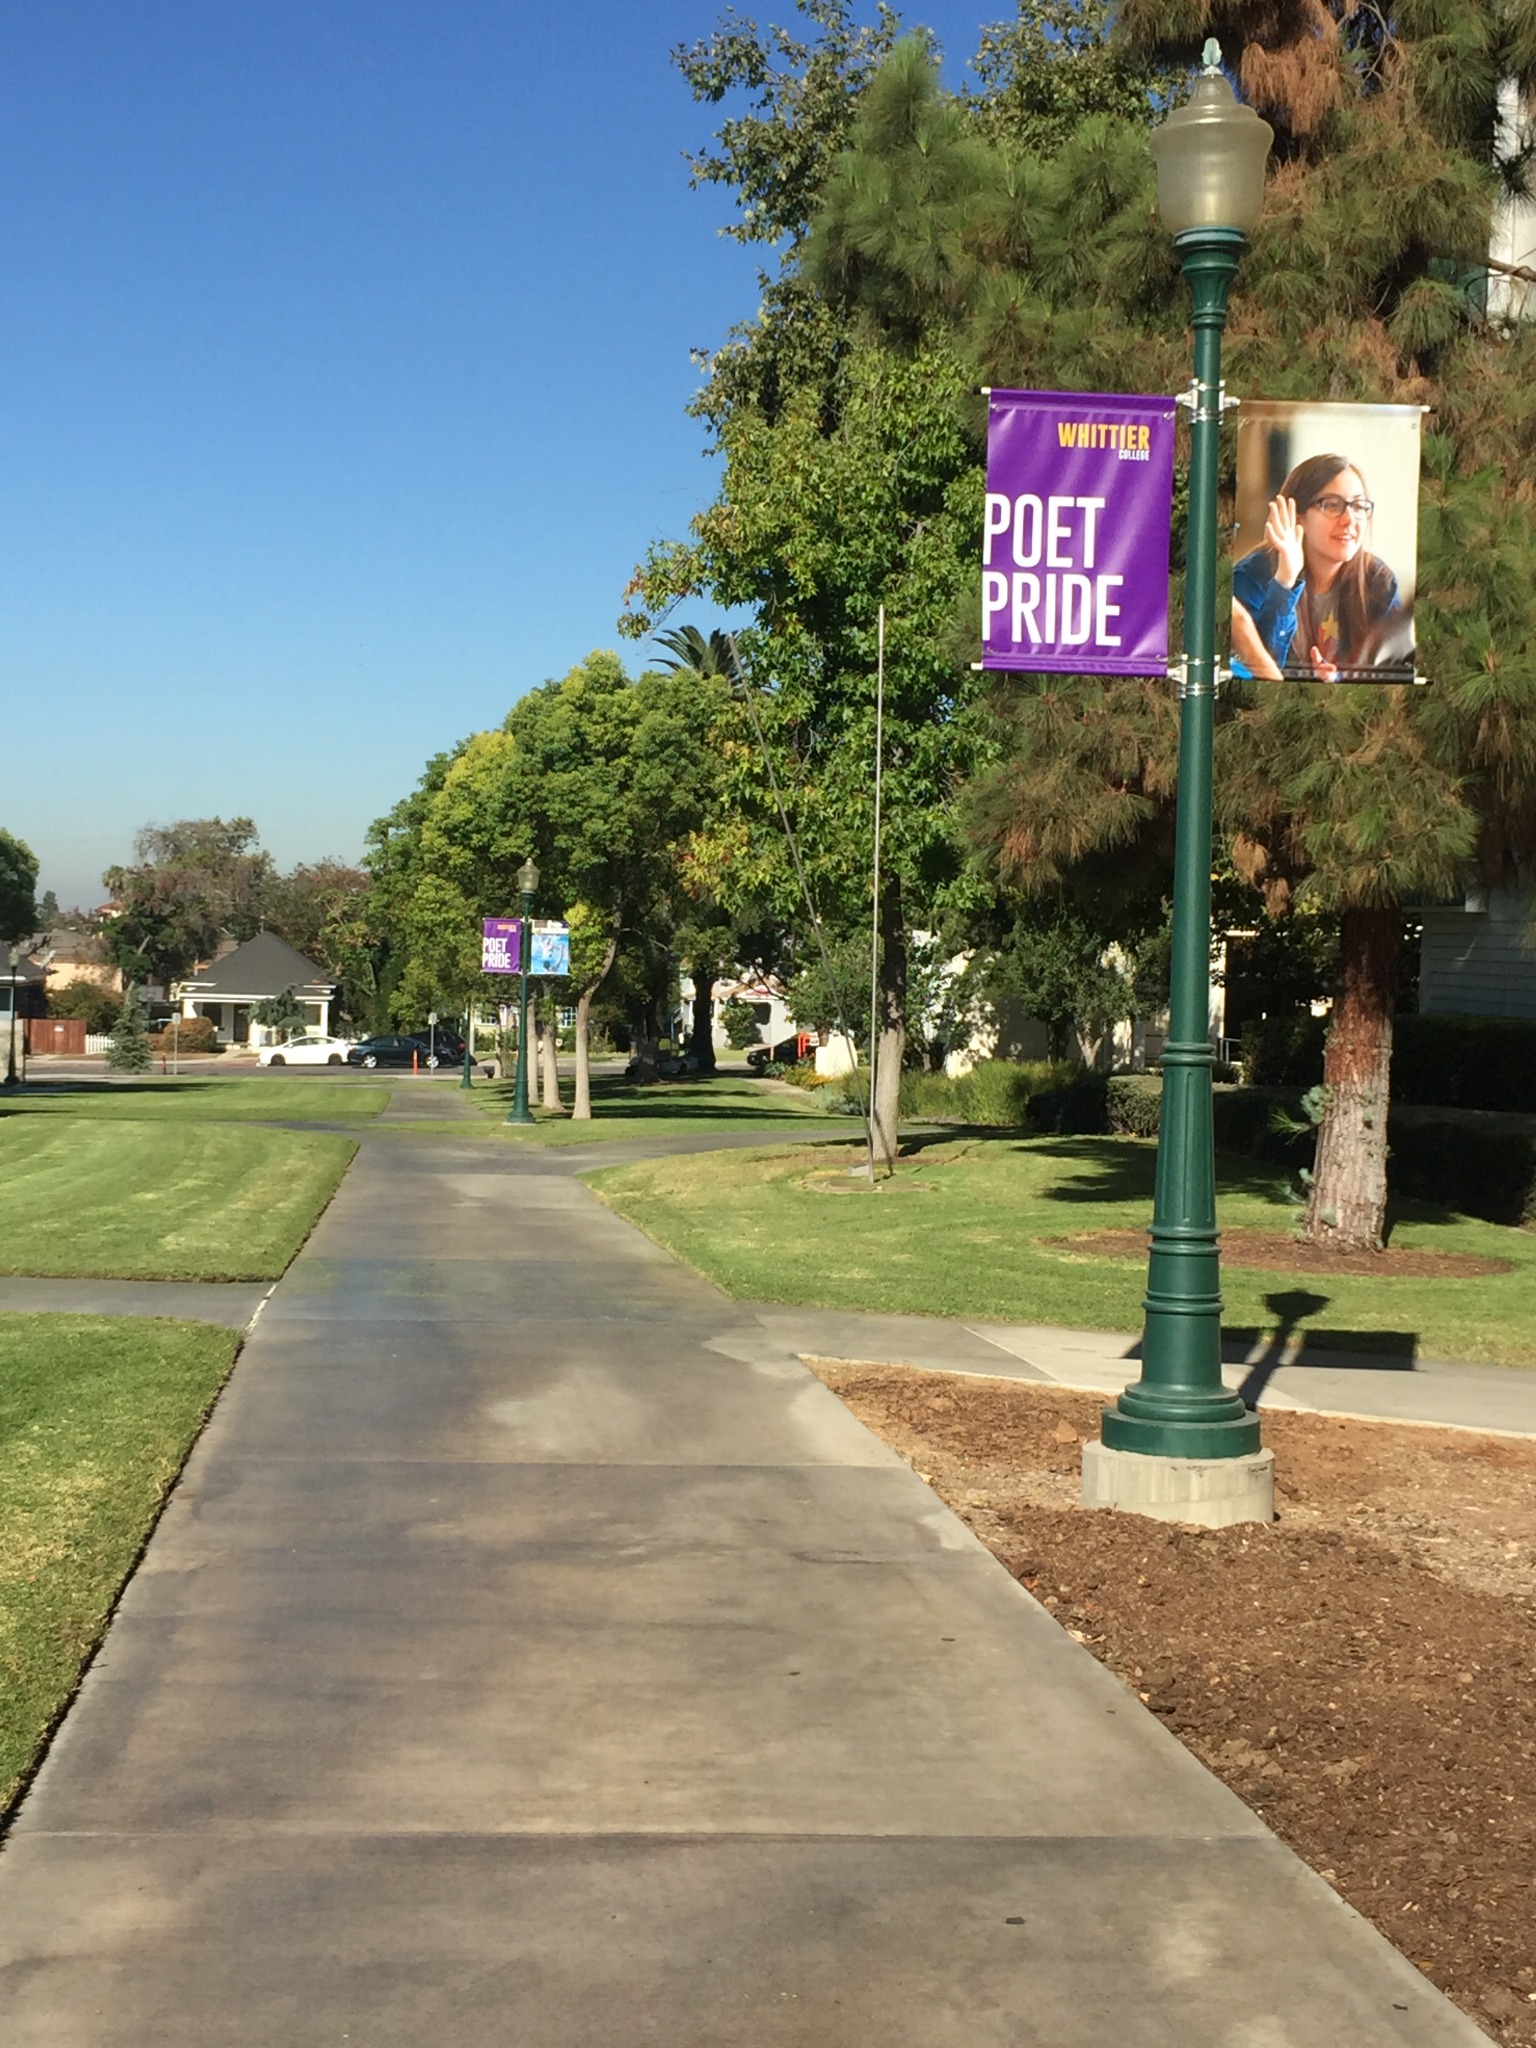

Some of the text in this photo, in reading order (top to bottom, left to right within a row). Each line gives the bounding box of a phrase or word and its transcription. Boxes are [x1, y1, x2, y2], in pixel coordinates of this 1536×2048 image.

[1057, 422, 1150, 450] WHITTIER
[1118, 449, 1150, 461] COLLEGE
[982, 493, 1106, 569] POET
[981, 572, 1124, 647] PRIDE
[482, 937, 508, 953] POET
[482, 953, 511, 969] PRIDE
